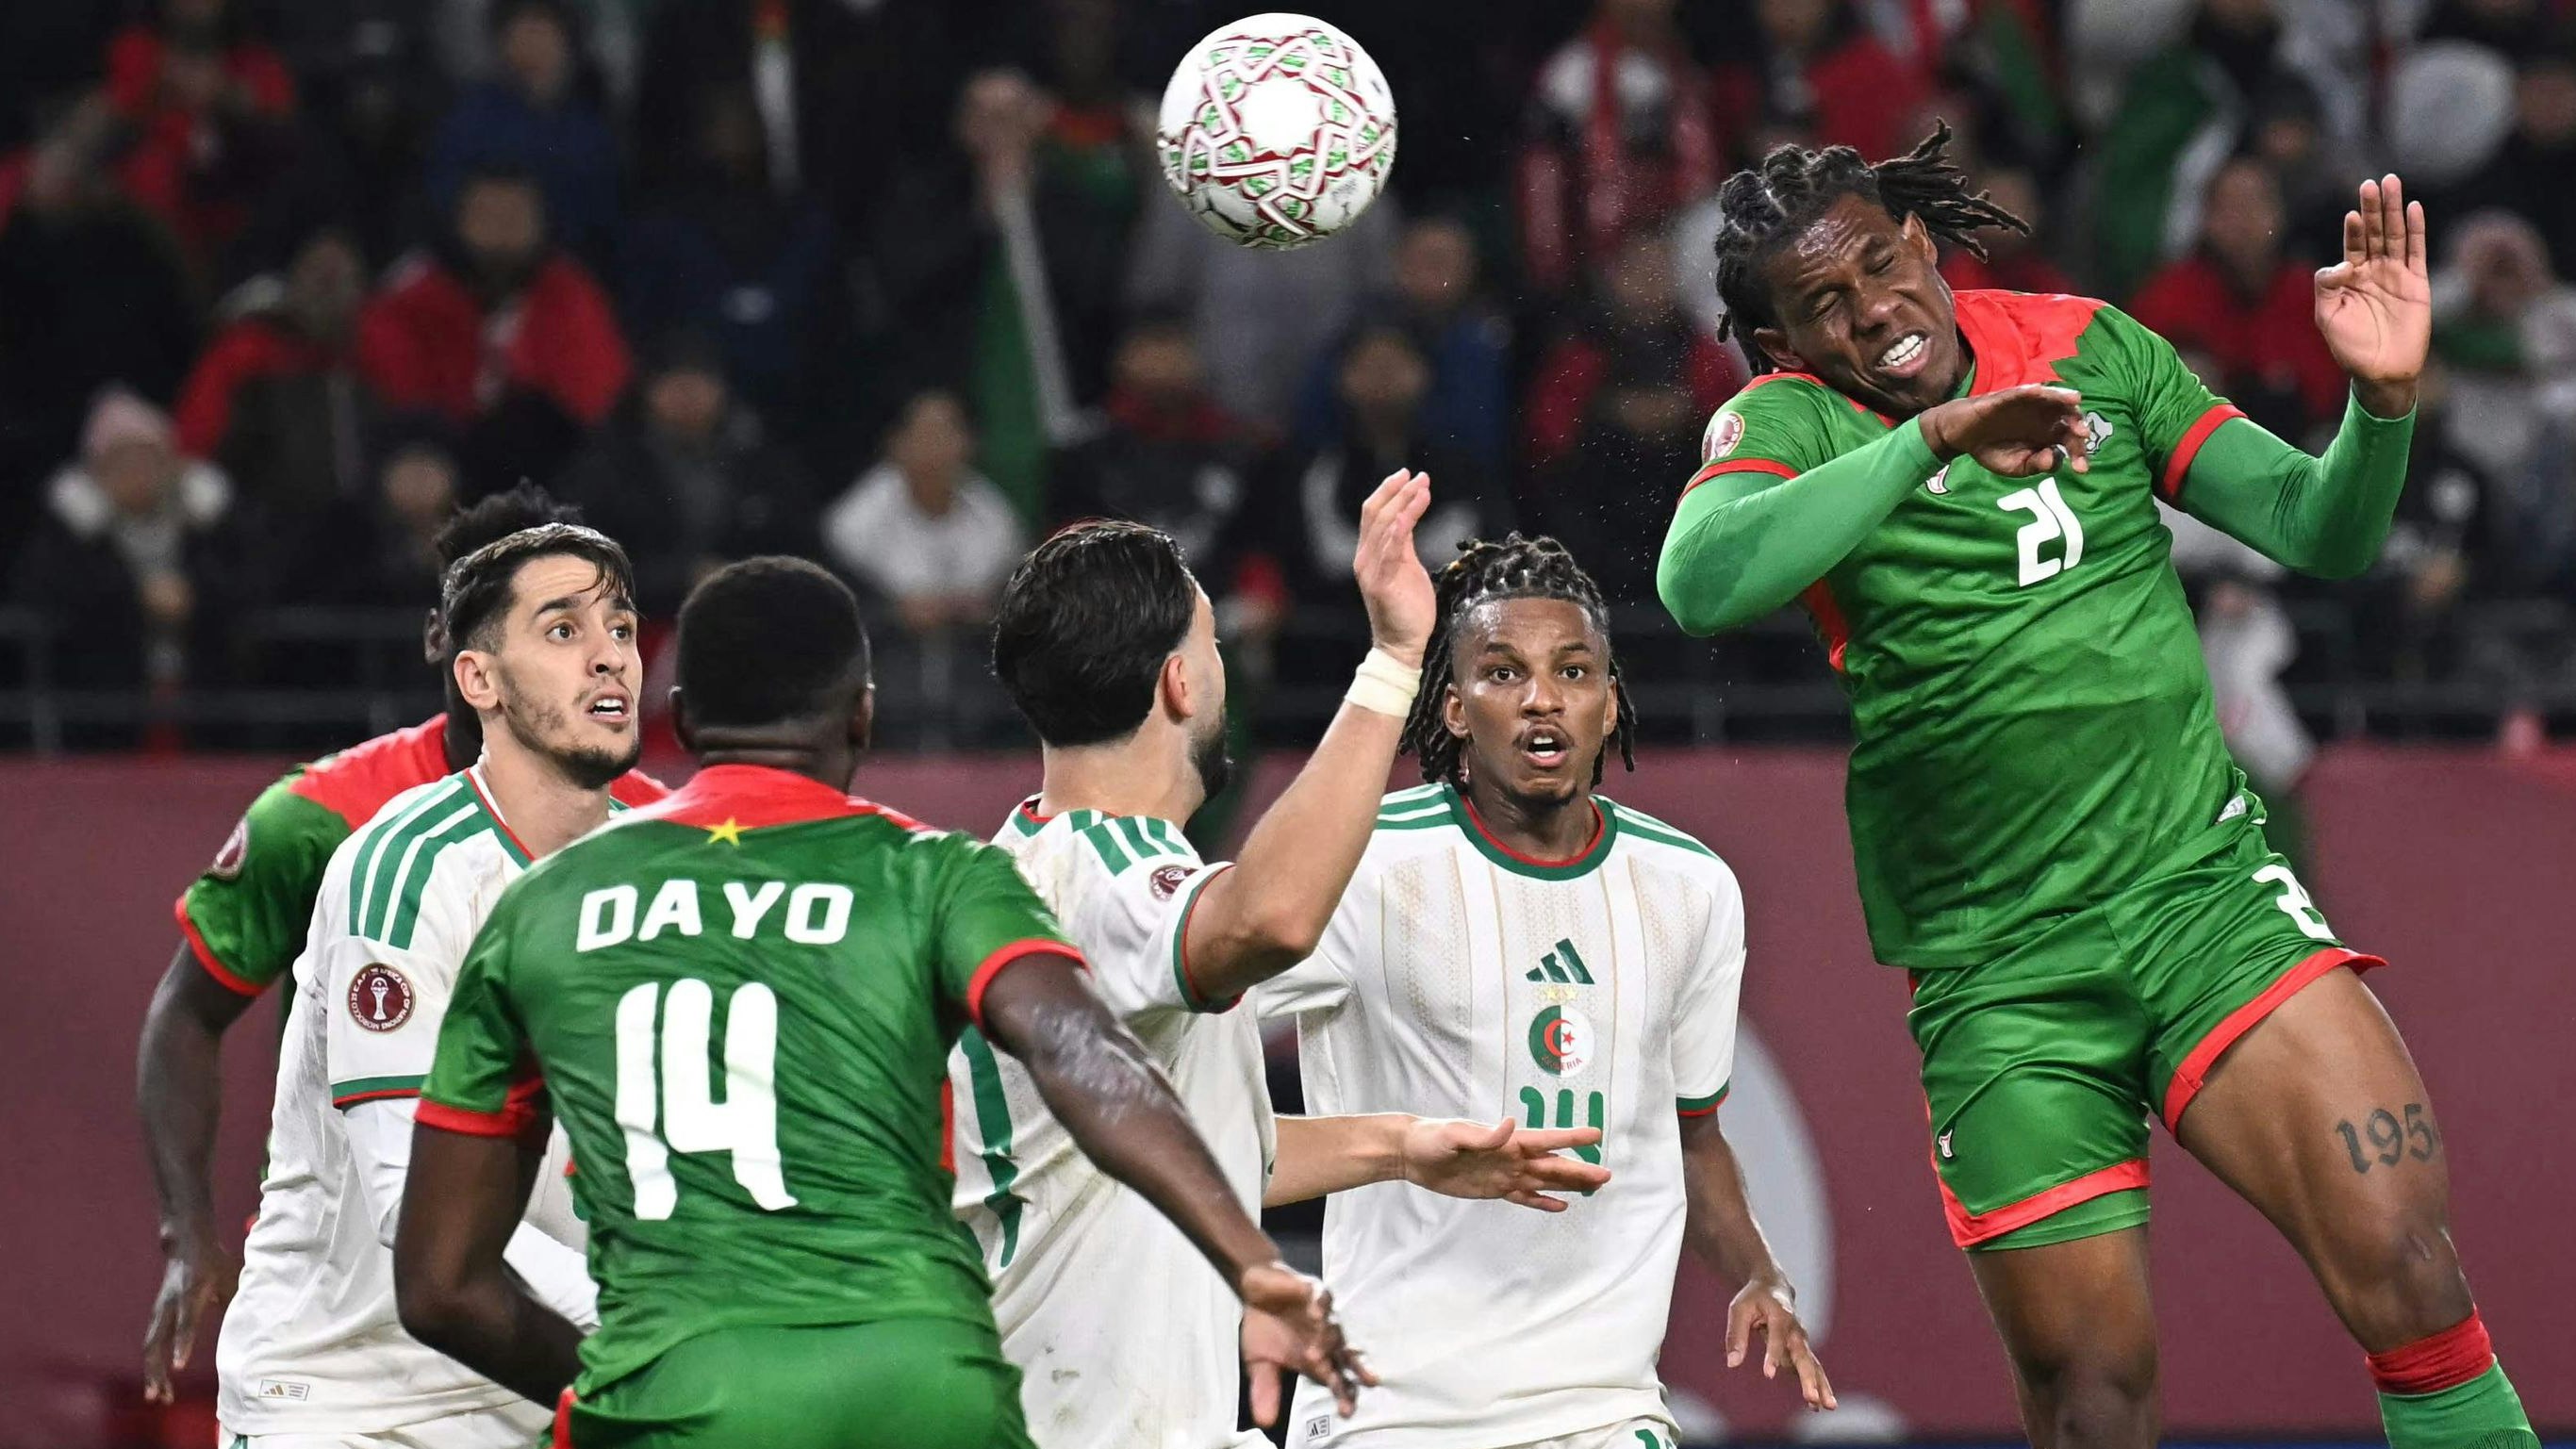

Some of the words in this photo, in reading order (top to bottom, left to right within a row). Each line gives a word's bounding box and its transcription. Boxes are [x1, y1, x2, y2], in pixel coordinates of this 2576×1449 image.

[1996, 476, 2084, 587] 21
[576, 880, 854, 953] DAYO
[615, 978, 800, 1221] 14
